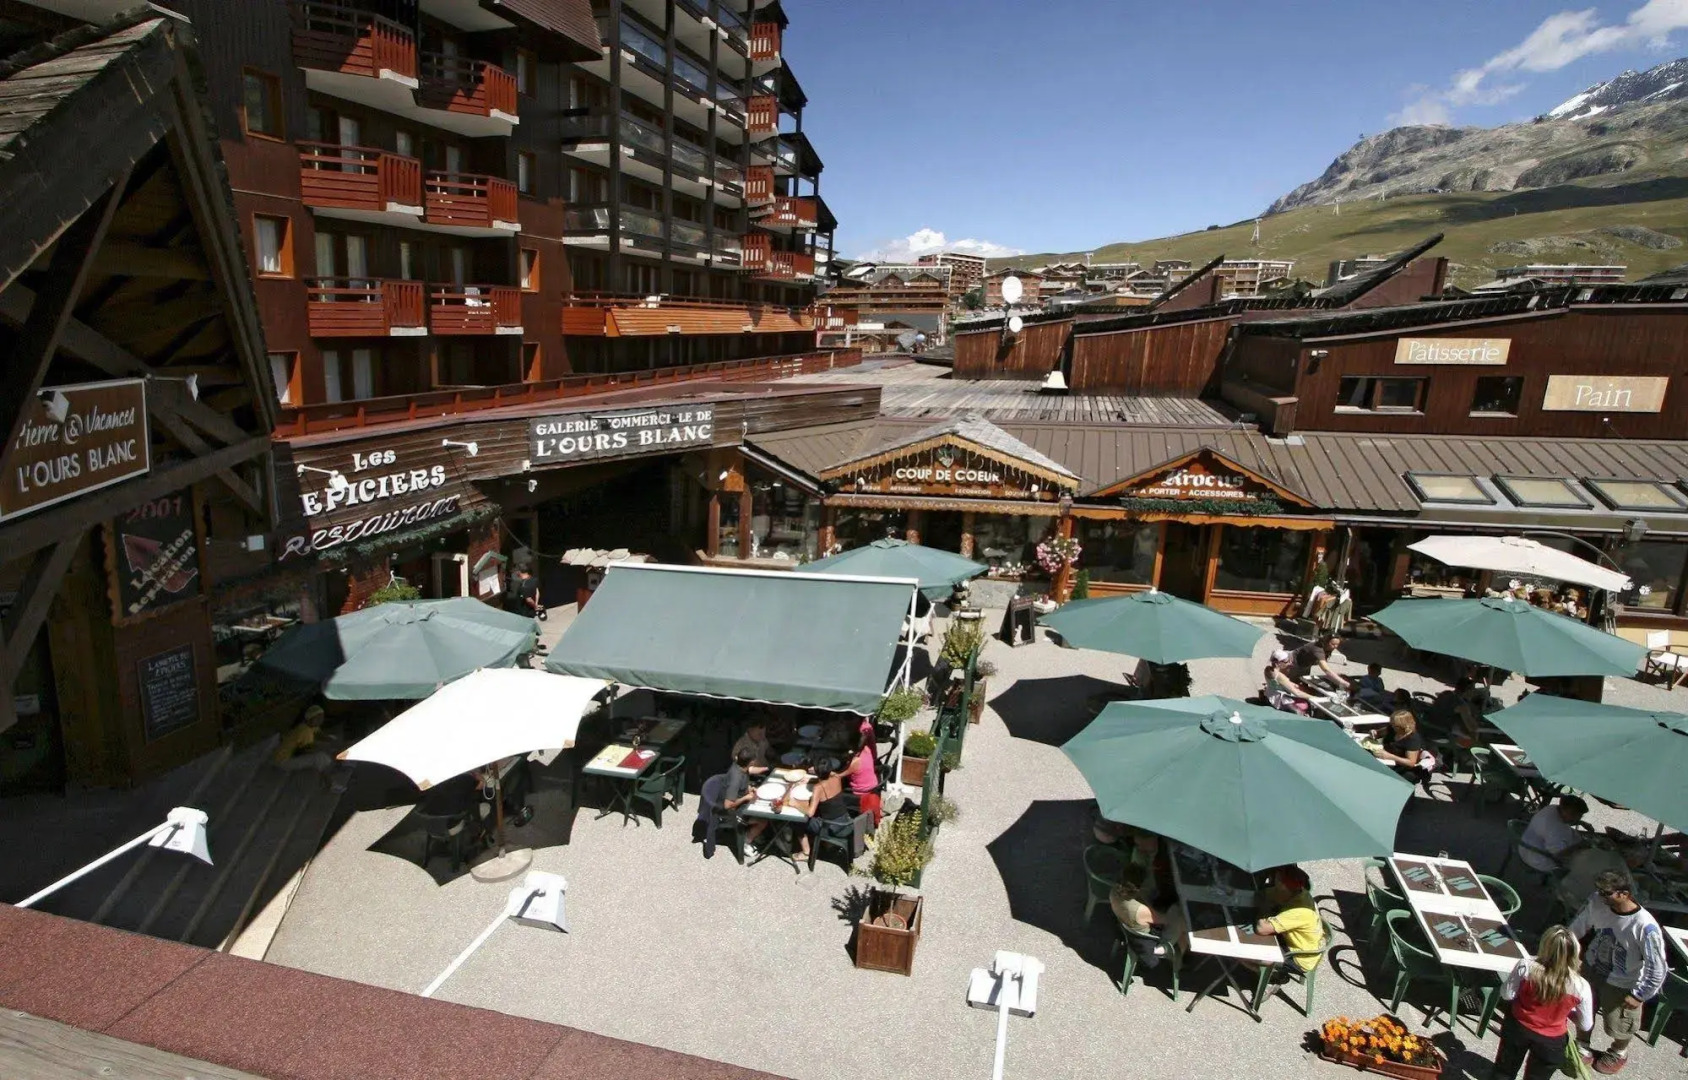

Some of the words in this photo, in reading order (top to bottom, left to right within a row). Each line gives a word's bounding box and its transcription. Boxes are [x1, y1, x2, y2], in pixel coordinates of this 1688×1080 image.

[1408, 340, 1500, 361] Pâtisserie
[1575, 383, 1632, 407] Pain
[86, 405, 135, 433] Vacances
[536, 420, 598, 435] GALERIE
[602, 411, 693, 430] OMMERCILE
[697, 411, 712, 421] DE
[536, 431, 628, 457] L'OURS
[639, 424, 712, 446] BLANC
[18, 453, 81, 492] L'OURS
[89, 438, 137, 472] BLANC
[352, 450, 397, 472] Les
[895, 467, 932, 480] COUP
[935, 469, 951, 481] DE
[955, 469, 1000, 483] COEUR
[300, 465, 446, 516] EPICIERS
[1188, 490, 1243, 498] ACCESSOIRES
[278, 493, 461, 560] Restaurant
[130, 529, 193, 590] Location
